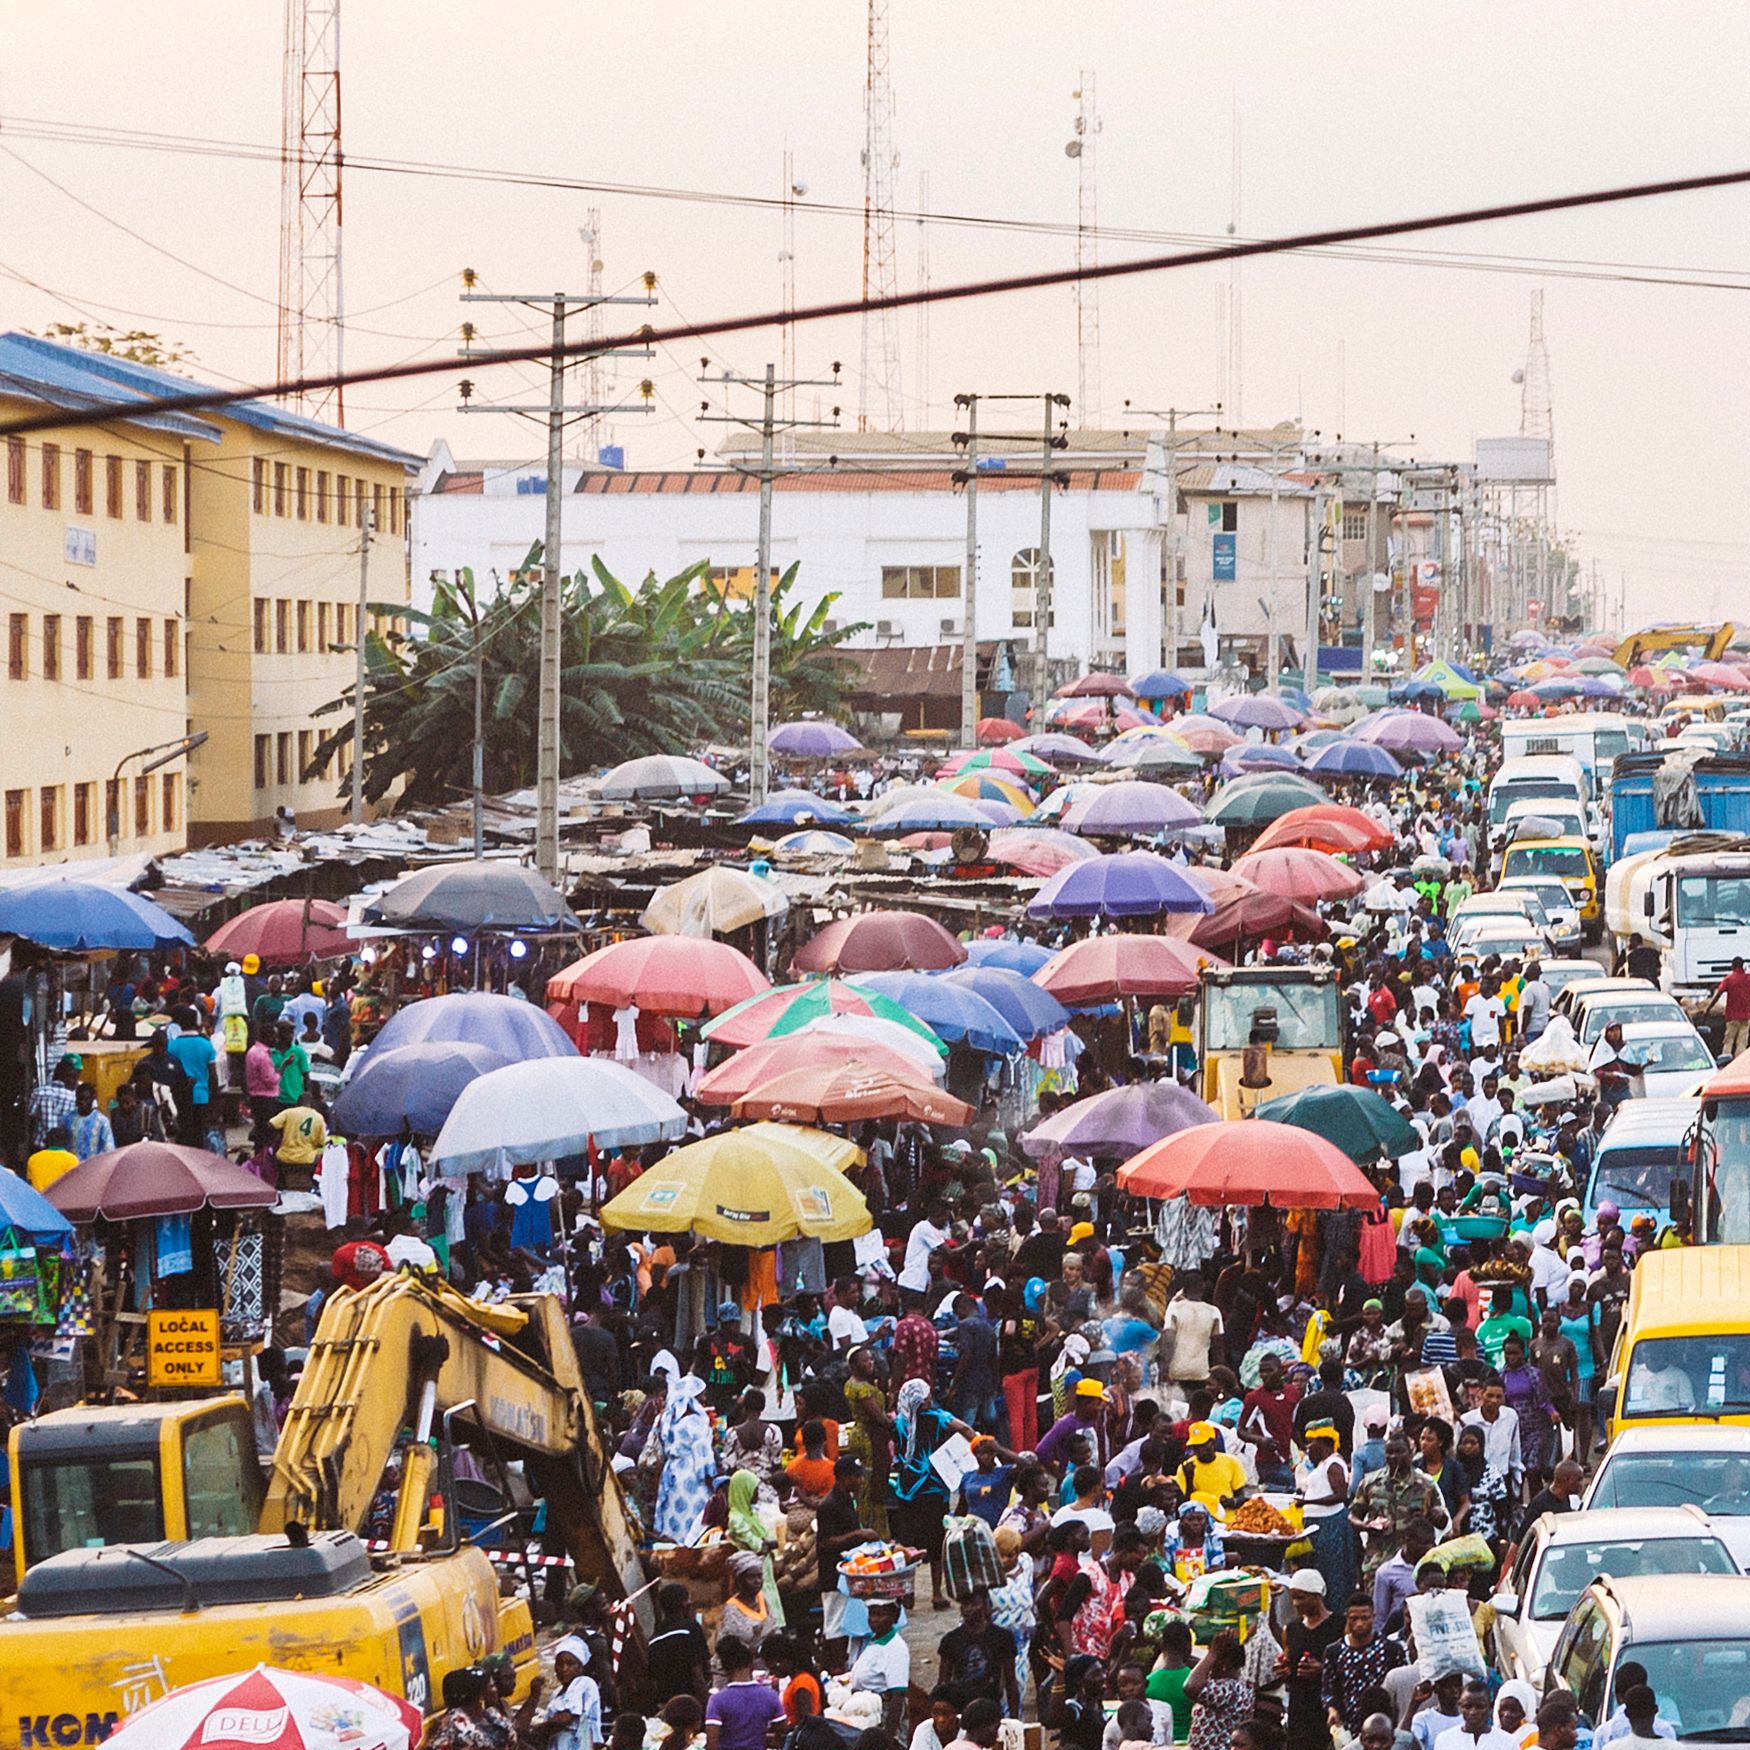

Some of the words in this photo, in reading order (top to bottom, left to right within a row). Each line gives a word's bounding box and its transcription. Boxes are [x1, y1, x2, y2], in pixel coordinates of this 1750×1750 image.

[300, 1117, 313, 1136] 4
[159, 1320, 208, 1333] LOCAL
[154, 1341, 214, 1353] ACCESS
[164, 1362, 204, 1374] ONLY
